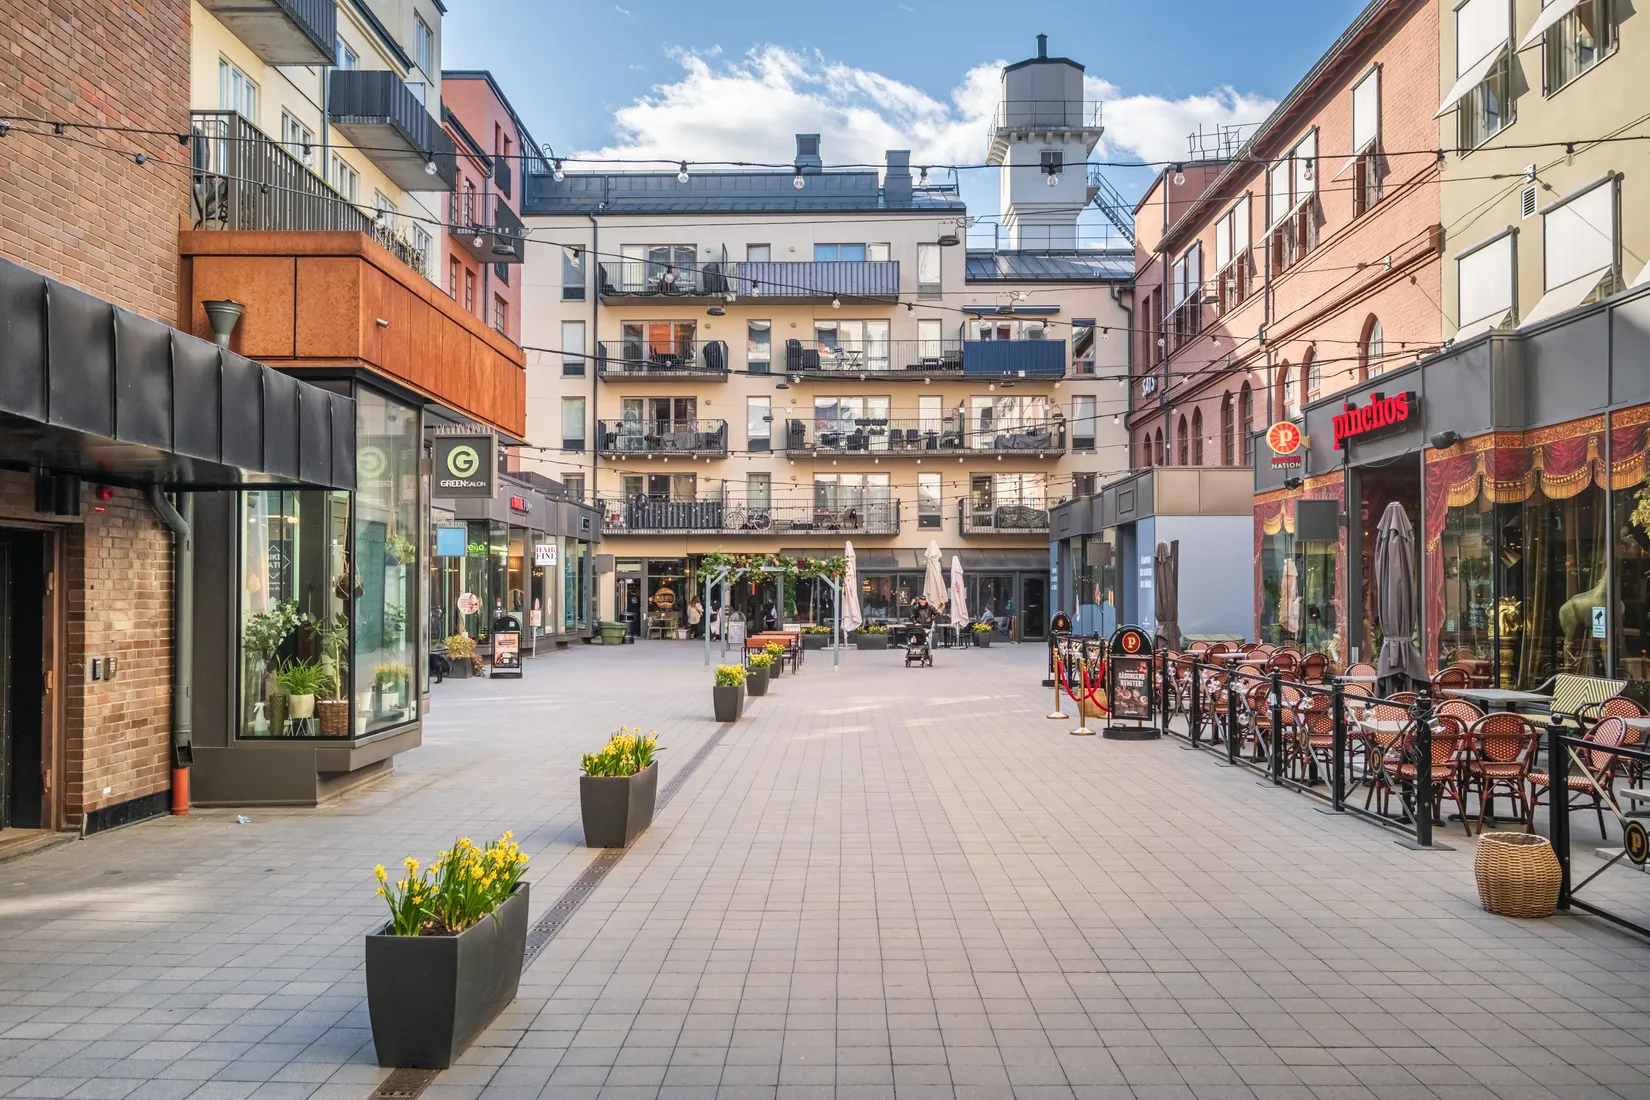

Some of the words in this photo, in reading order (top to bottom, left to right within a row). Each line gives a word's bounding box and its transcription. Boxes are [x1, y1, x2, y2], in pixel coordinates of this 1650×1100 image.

[1332, 391, 1409, 450] pinchos
[1278, 430, 1293, 446] P
[1127, 637, 1136, 648] P
[1631, 831, 1642, 853] P
